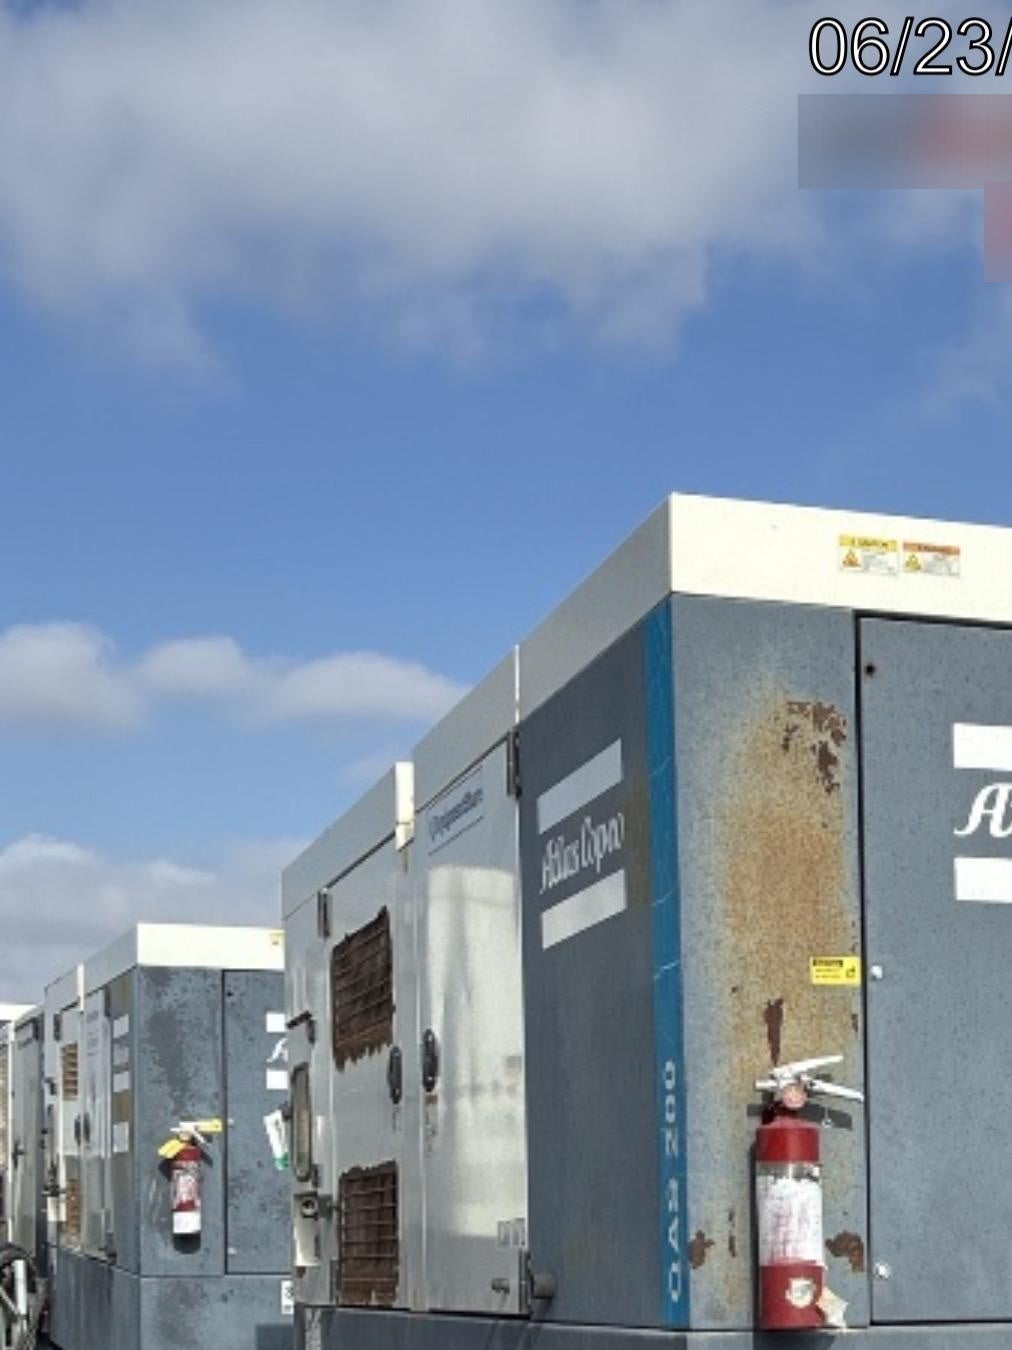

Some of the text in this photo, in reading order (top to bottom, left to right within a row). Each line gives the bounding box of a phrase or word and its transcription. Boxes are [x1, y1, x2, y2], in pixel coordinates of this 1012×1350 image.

[539, 812, 625, 895] Atlas Copco
[663, 1058, 679, 1156] 200
